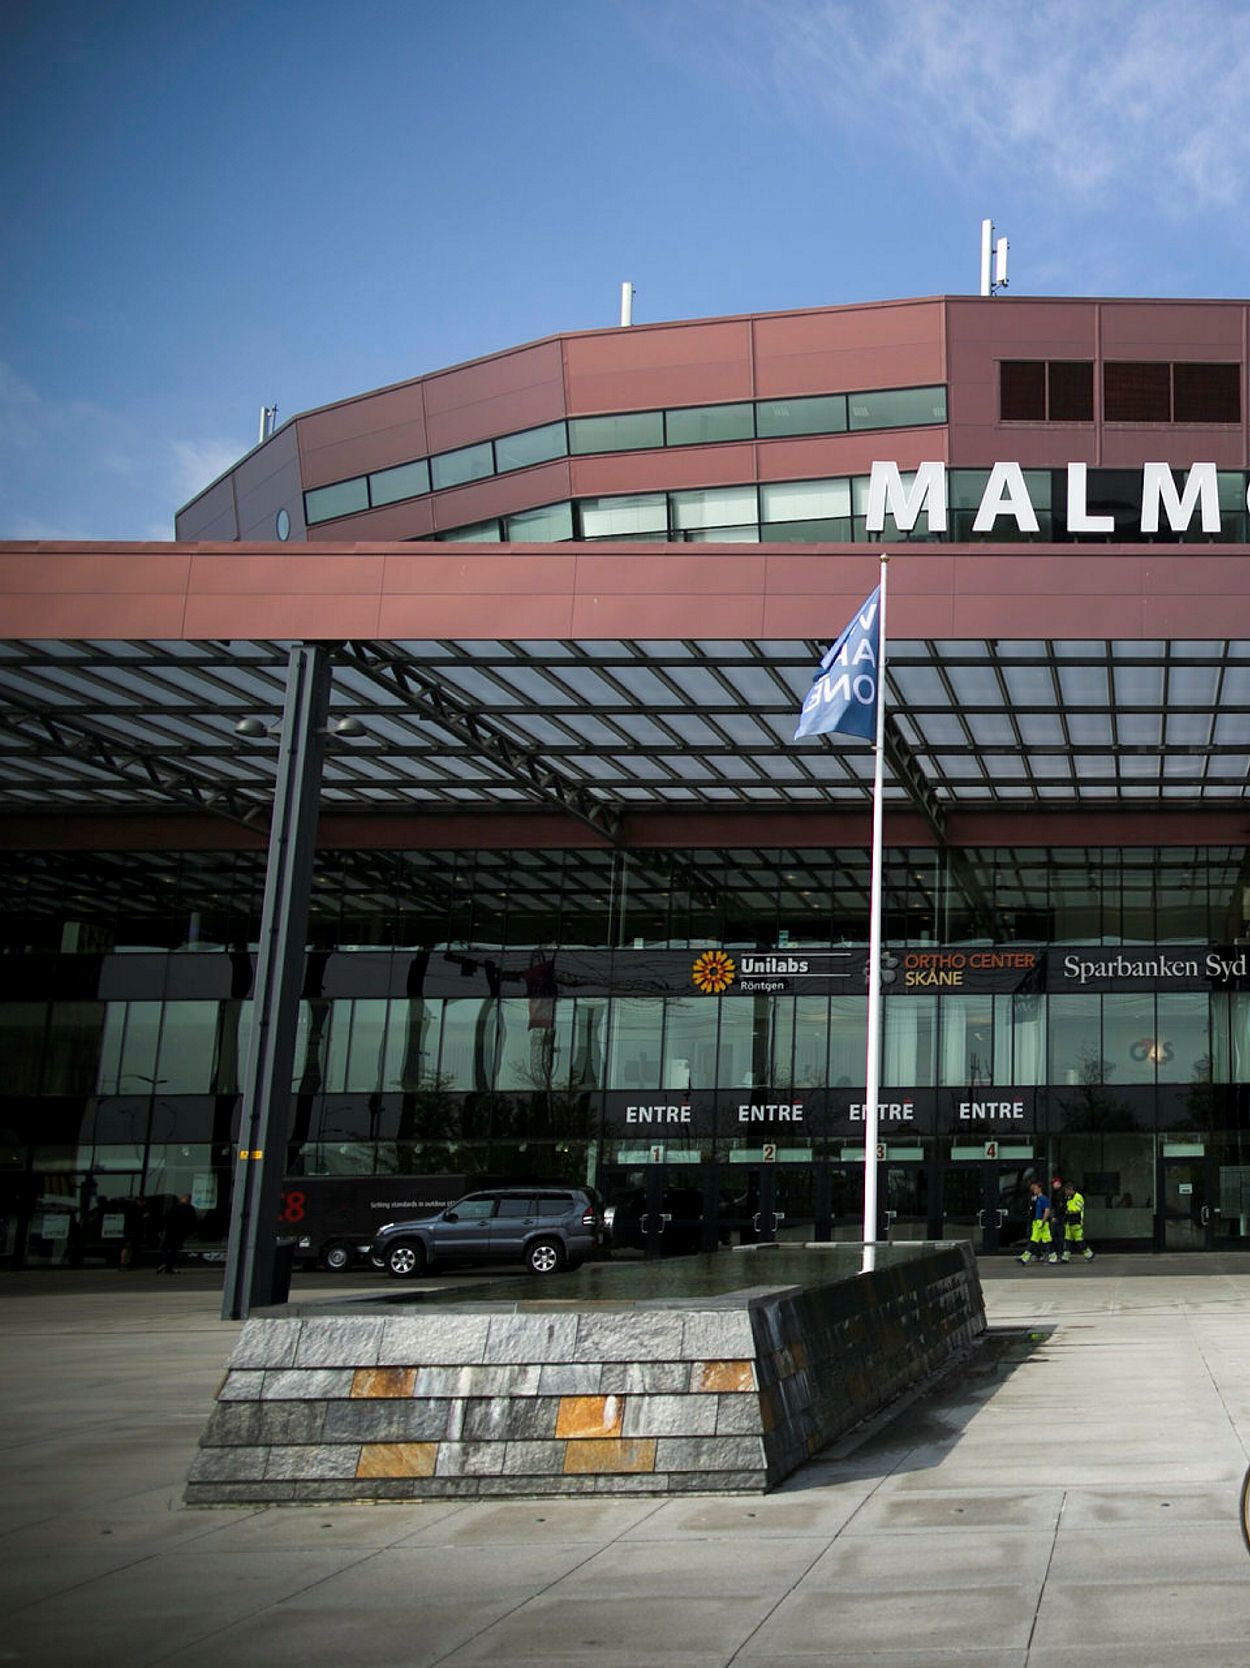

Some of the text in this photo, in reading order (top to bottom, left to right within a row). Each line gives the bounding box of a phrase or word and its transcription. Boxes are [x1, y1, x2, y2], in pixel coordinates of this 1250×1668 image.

[741, 957, 809, 973] Unilabs
[904, 953, 1036, 969] ORTHO CENTER
[1064, 953, 1247, 984] Sparbanken Syd
[905, 967, 963, 986] SKÅNE
[740, 981, 784, 992] Röntgen
[849, 1103, 914, 1120] ETRE
[653, 1148, 660, 1161] 1
[765, 1146, 773, 1160] 2
[877, 1145, 884, 1159] 3
[987, 1144, 996, 1158] 4
